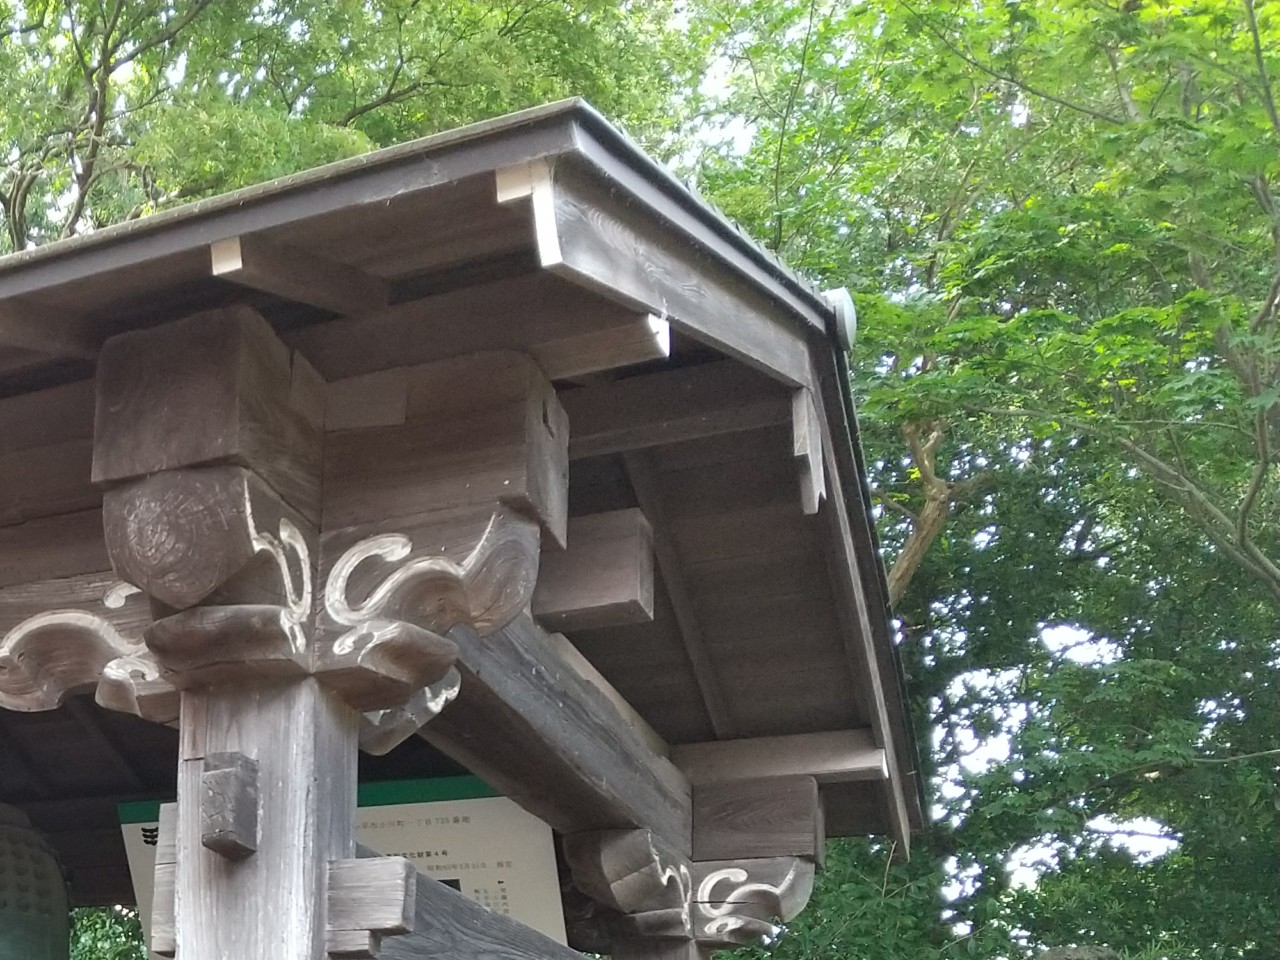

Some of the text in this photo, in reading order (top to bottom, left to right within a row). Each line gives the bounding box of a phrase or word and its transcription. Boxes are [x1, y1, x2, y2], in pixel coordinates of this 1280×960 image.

[386, 849, 448, 859] 文化財第4号
